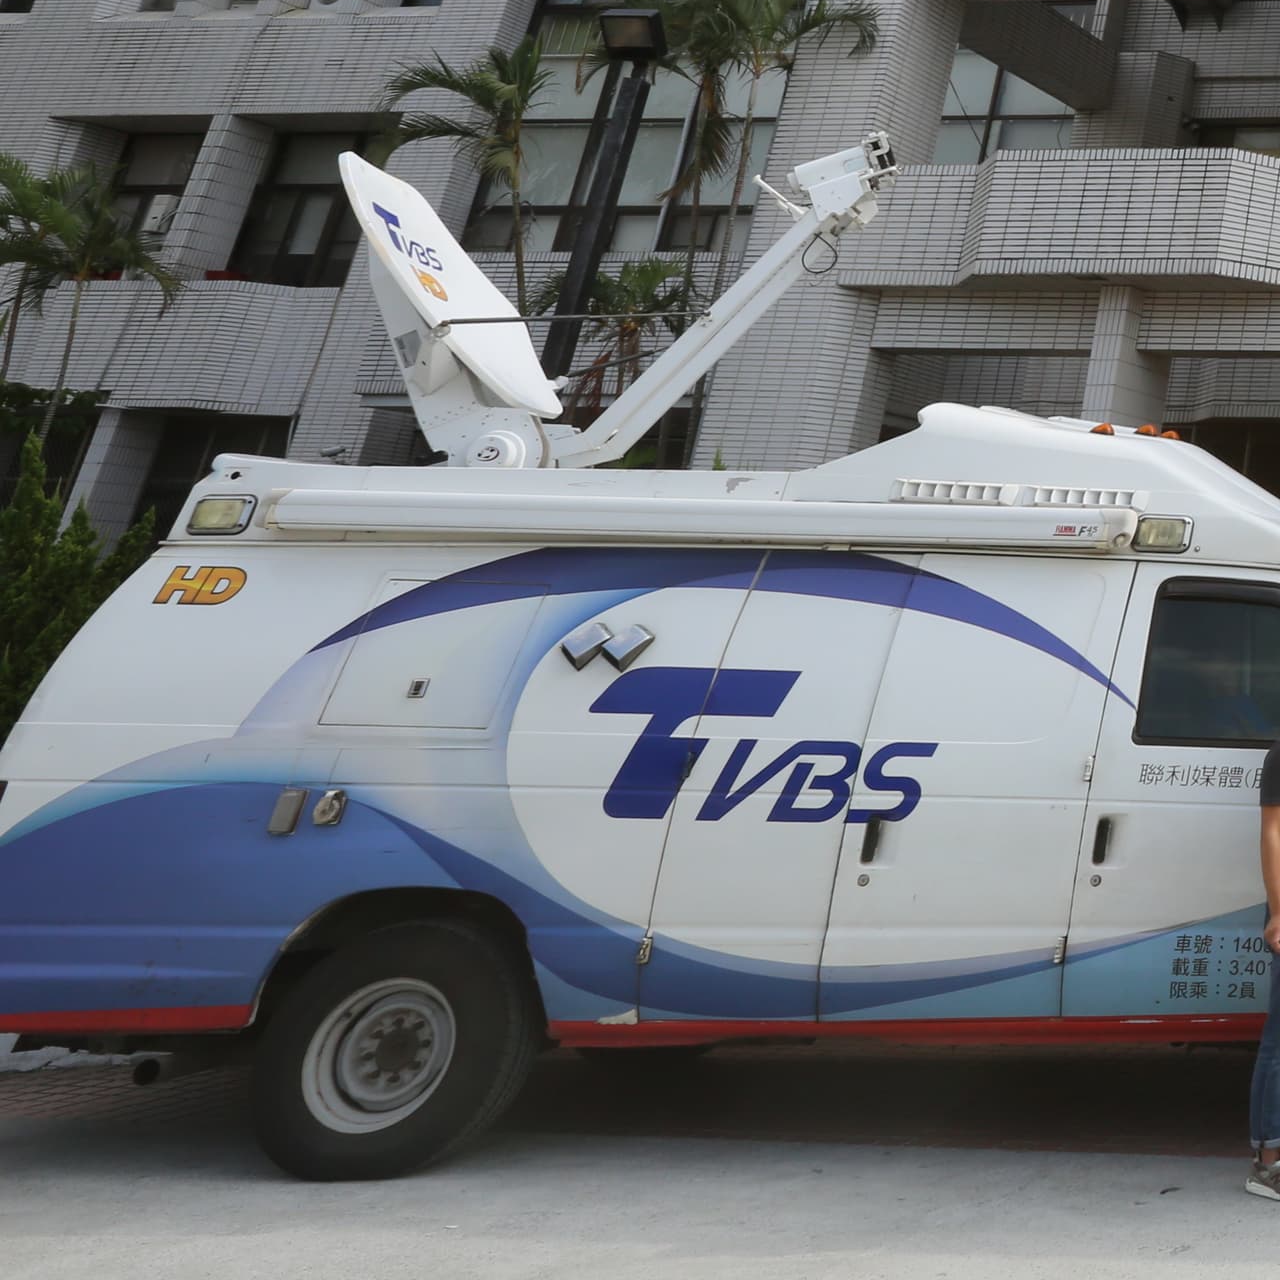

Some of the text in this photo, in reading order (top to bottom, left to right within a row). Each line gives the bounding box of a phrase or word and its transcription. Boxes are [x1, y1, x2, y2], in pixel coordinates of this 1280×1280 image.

[371, 201, 443, 271] TVBS
[151, 565, 248, 606] HD
[588, 665, 940, 824] TVBS
